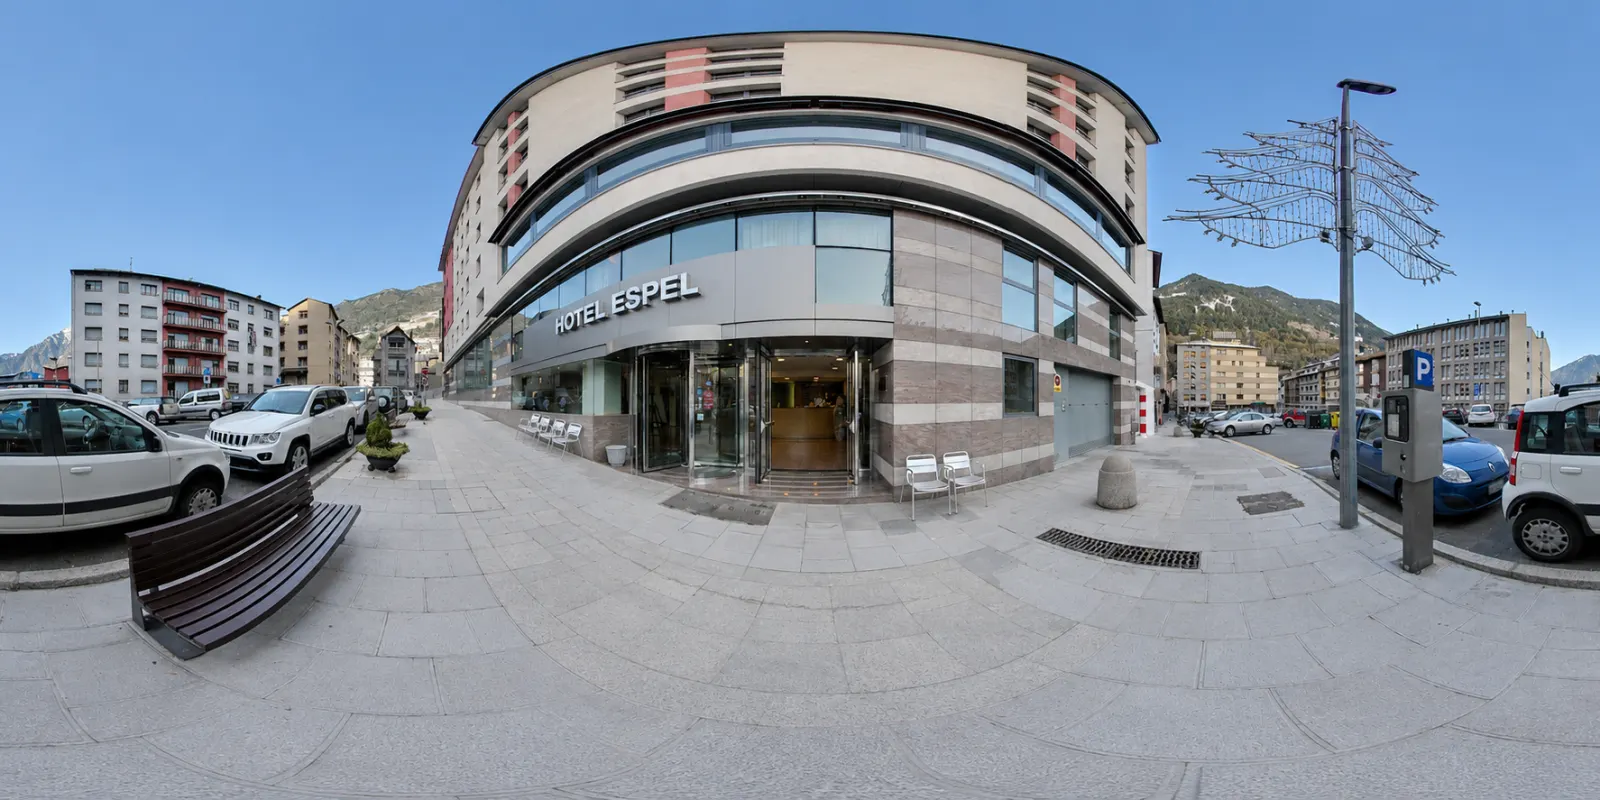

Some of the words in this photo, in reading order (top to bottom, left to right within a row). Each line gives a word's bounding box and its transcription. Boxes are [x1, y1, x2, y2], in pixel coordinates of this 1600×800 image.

[555, 300, 606, 335] HOTEL
[611, 272, 700, 314] ESPEL
[1417, 356, 1431, 381] P
